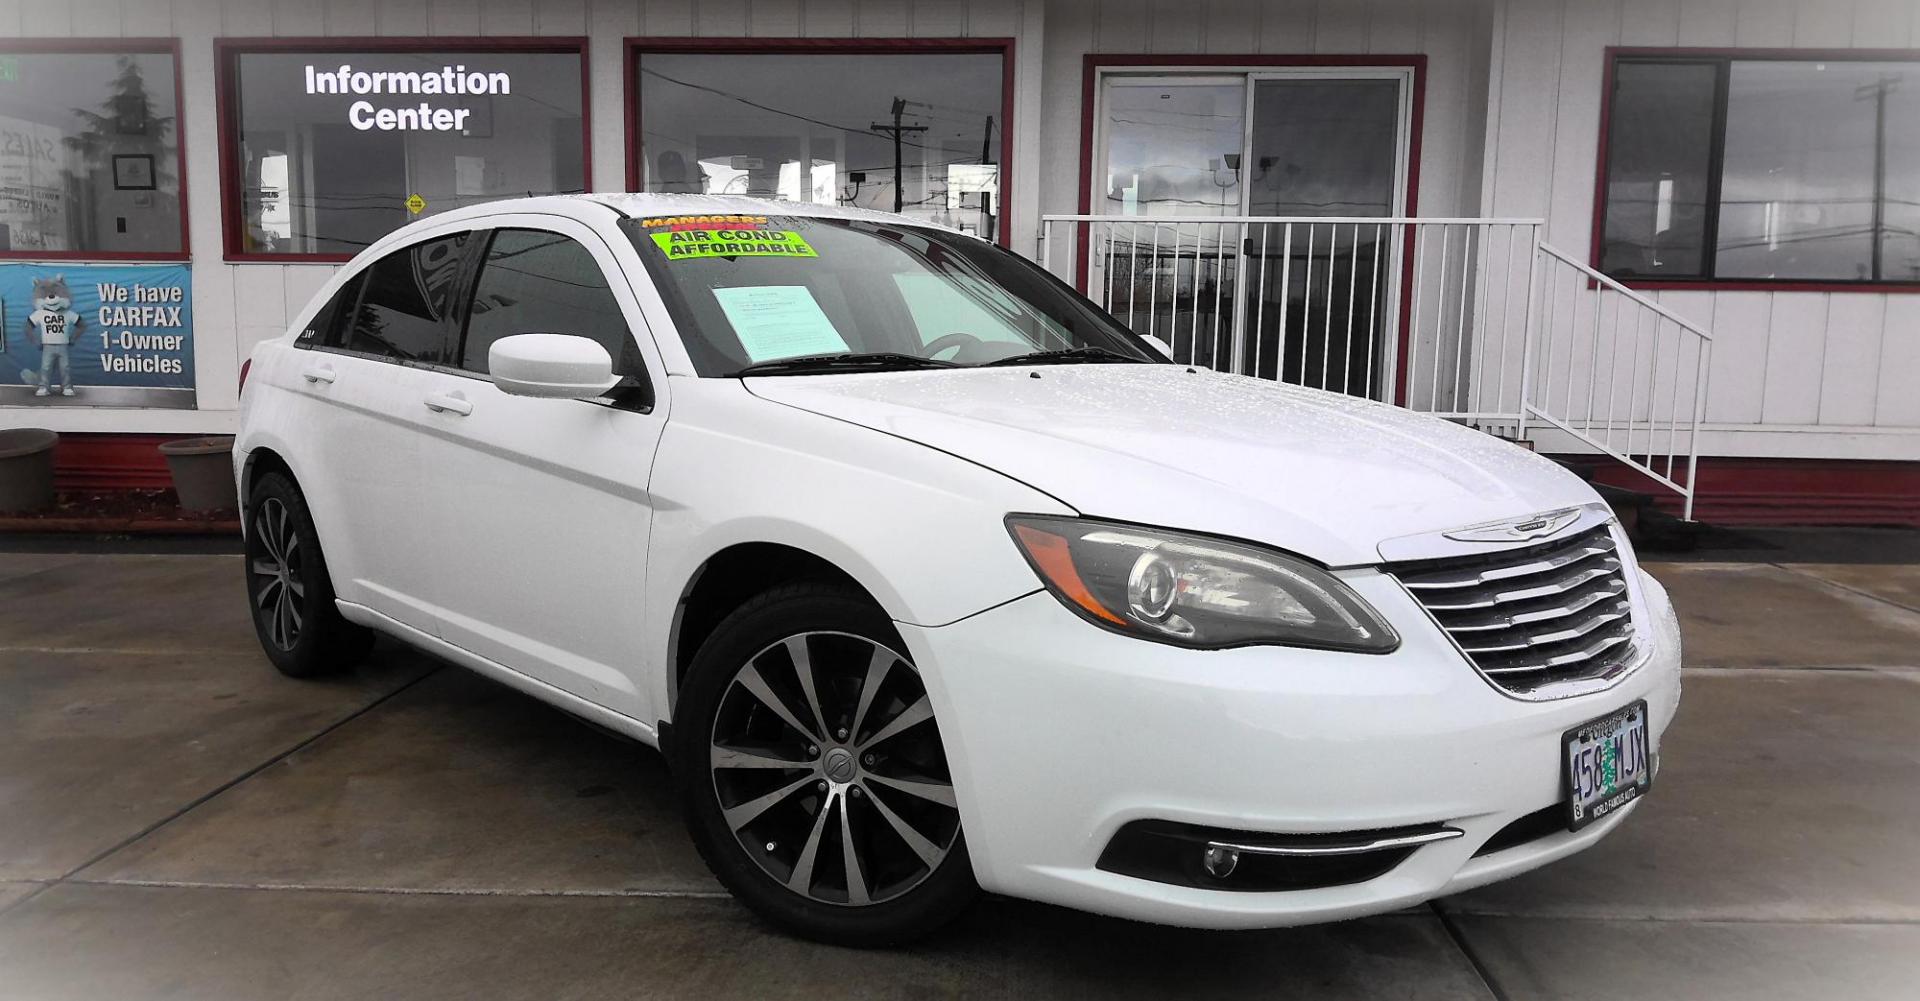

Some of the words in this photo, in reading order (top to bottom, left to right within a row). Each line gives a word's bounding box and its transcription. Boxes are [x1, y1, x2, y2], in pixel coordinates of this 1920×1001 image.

[304, 65, 511, 95] Information
[349, 101, 471, 130] Center
[642, 215, 768, 228] MANAGERS
[670, 231, 712, 243] AIR
[670, 242, 808, 256] AFFORDABLE
[97, 283, 128, 304] We
[135, 283, 183, 304] have
[44, 315, 65, 324] CAR
[99, 306, 183, 332] CARFAX
[46, 324, 65, 334] FOX
[100, 330, 184, 351] 1-Owner
[101, 353, 183, 374] Vehicles
[1573, 744, 1603, 801] 458
[1614, 724, 1645, 782] MJX
[1624, 786, 1636, 801] AUTO
[1574, 804, 1581, 818] 8
